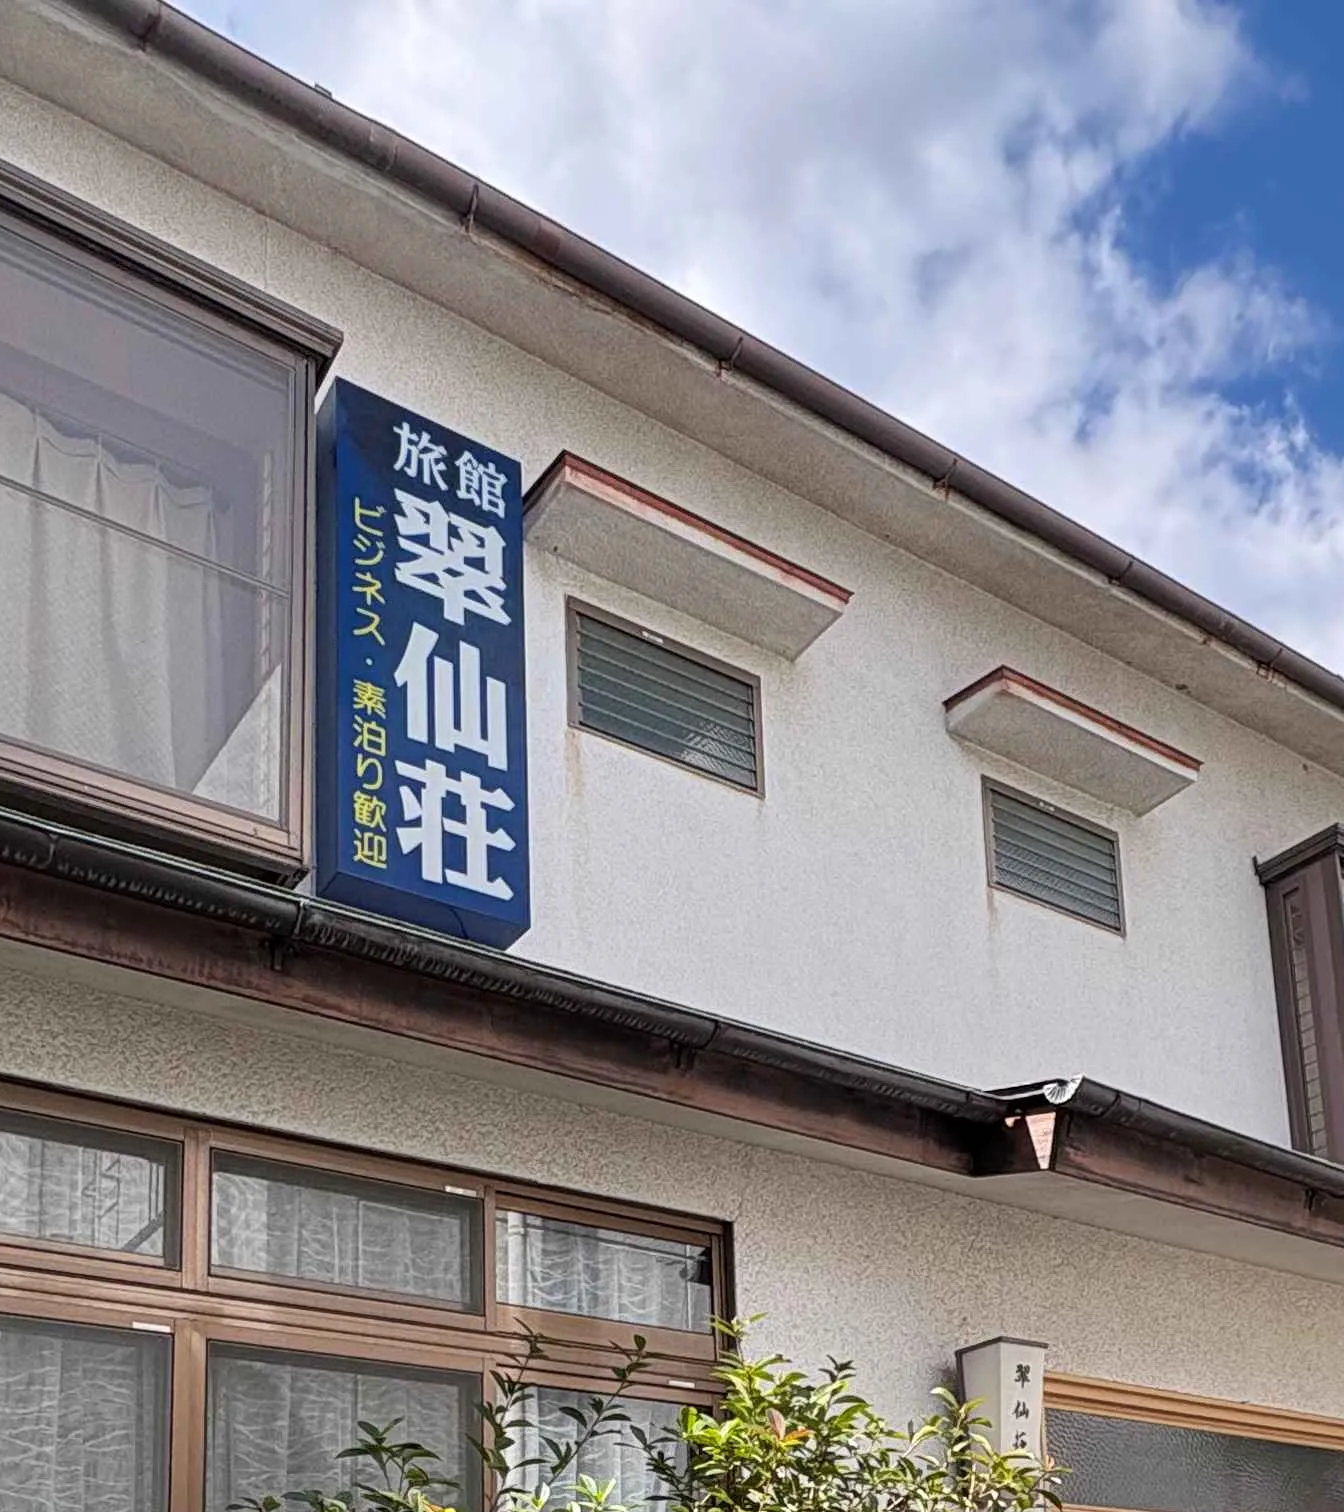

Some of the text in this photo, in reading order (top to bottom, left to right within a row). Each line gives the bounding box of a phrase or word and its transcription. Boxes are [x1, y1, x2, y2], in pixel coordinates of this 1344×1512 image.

[393, 421, 507, 519] 旅館
[352, 496, 388, 869] ビジネス・素泊り歓迎
[394, 487, 516, 901] 翠仙荘
